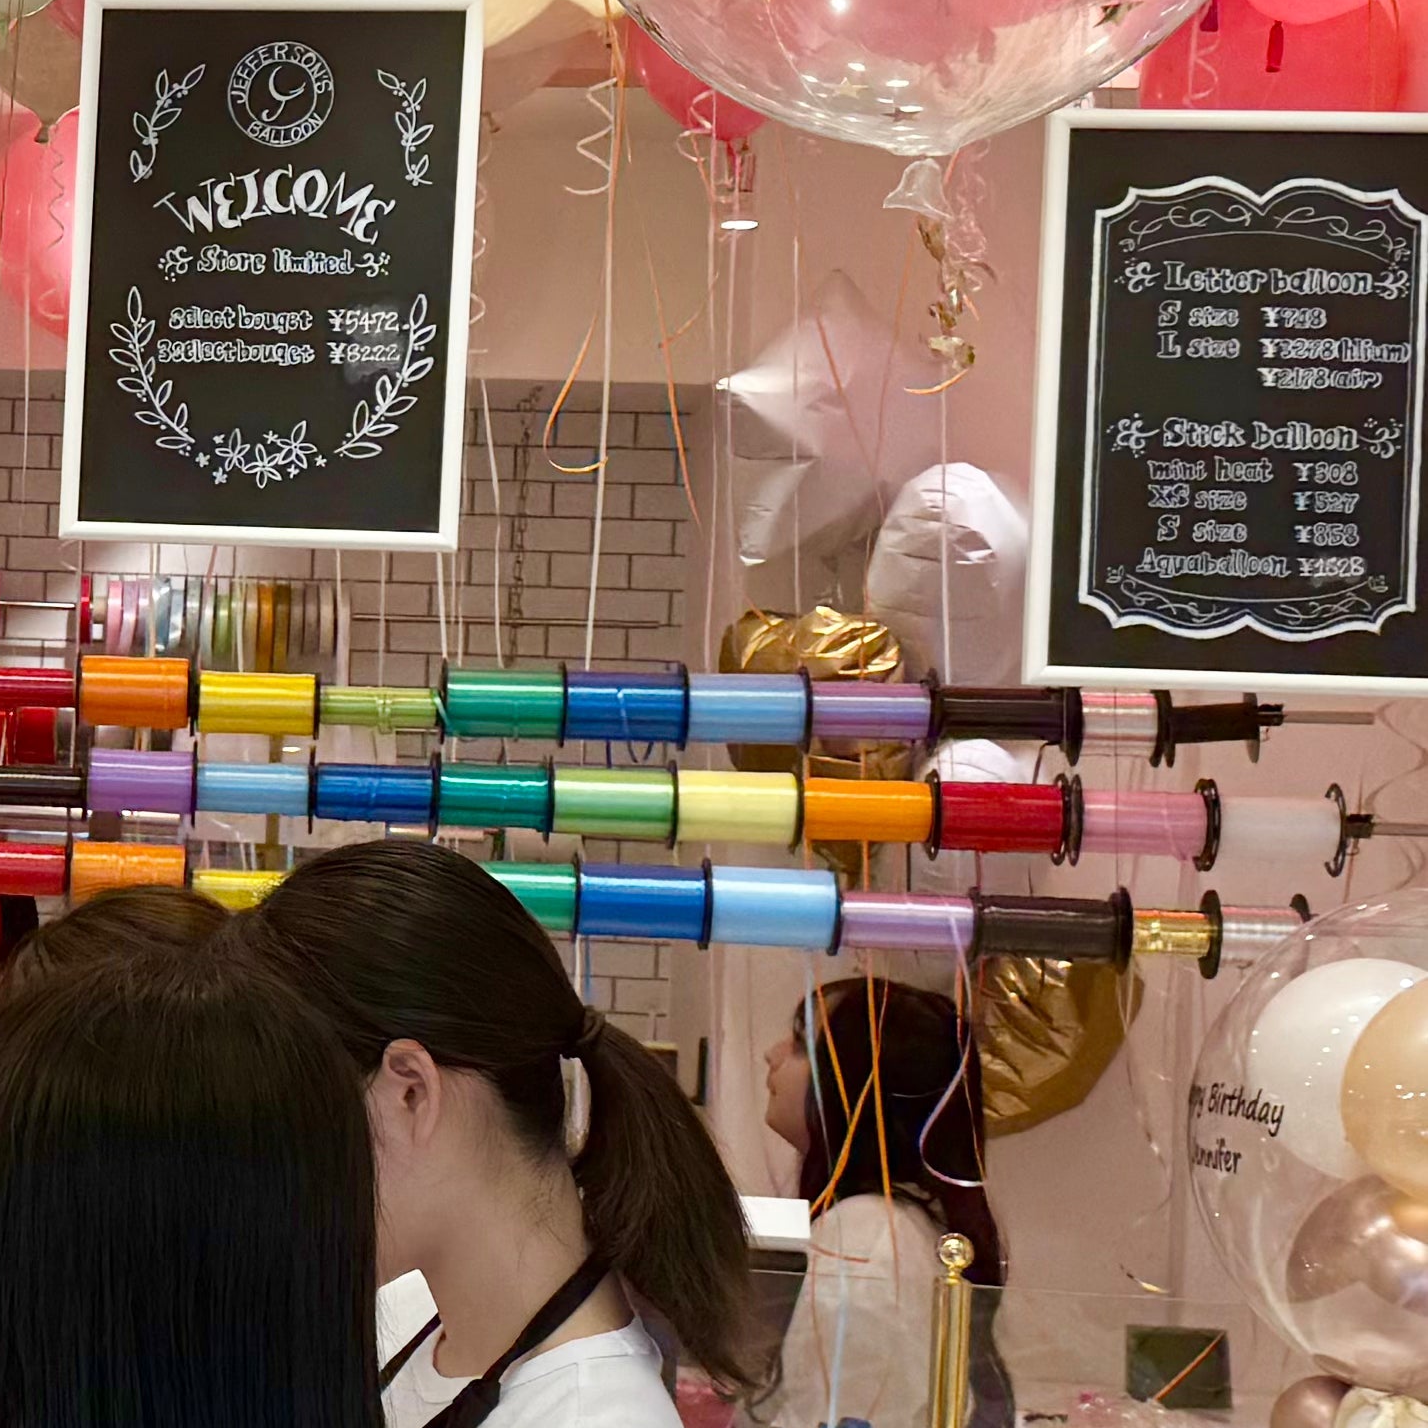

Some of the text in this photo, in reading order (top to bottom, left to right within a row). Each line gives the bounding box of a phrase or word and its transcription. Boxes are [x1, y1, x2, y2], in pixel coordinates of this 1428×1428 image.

[231, 43, 333, 104] JEFFERSON'S
[246, 112, 323, 145] BALLOON
[152, 164, 396, 246] WELCOME
[197, 244, 355, 274] Store limited
[1163, 260, 1374, 295] Letter balloon
[327, 309, 400, 334] ¥5472
[1158, 299, 1182, 327] S
[1188, 305, 1240, 328] size
[326, 341, 400, 365] ¥8222
[1156, 330, 1181, 359] L
[1186, 336, 1241, 359] size
[1162, 417, 1360, 451] Stick balloon
[1147, 458, 1208, 481] mini
[1293, 460, 1360, 486] ¥308
[1147, 483, 1191, 509] XS
[1194, 489, 1248, 511] size
[1157, 514, 1181, 542] S
[1192, 519, 1248, 543] size
[1208, 1082, 1285, 1138] Birthday
